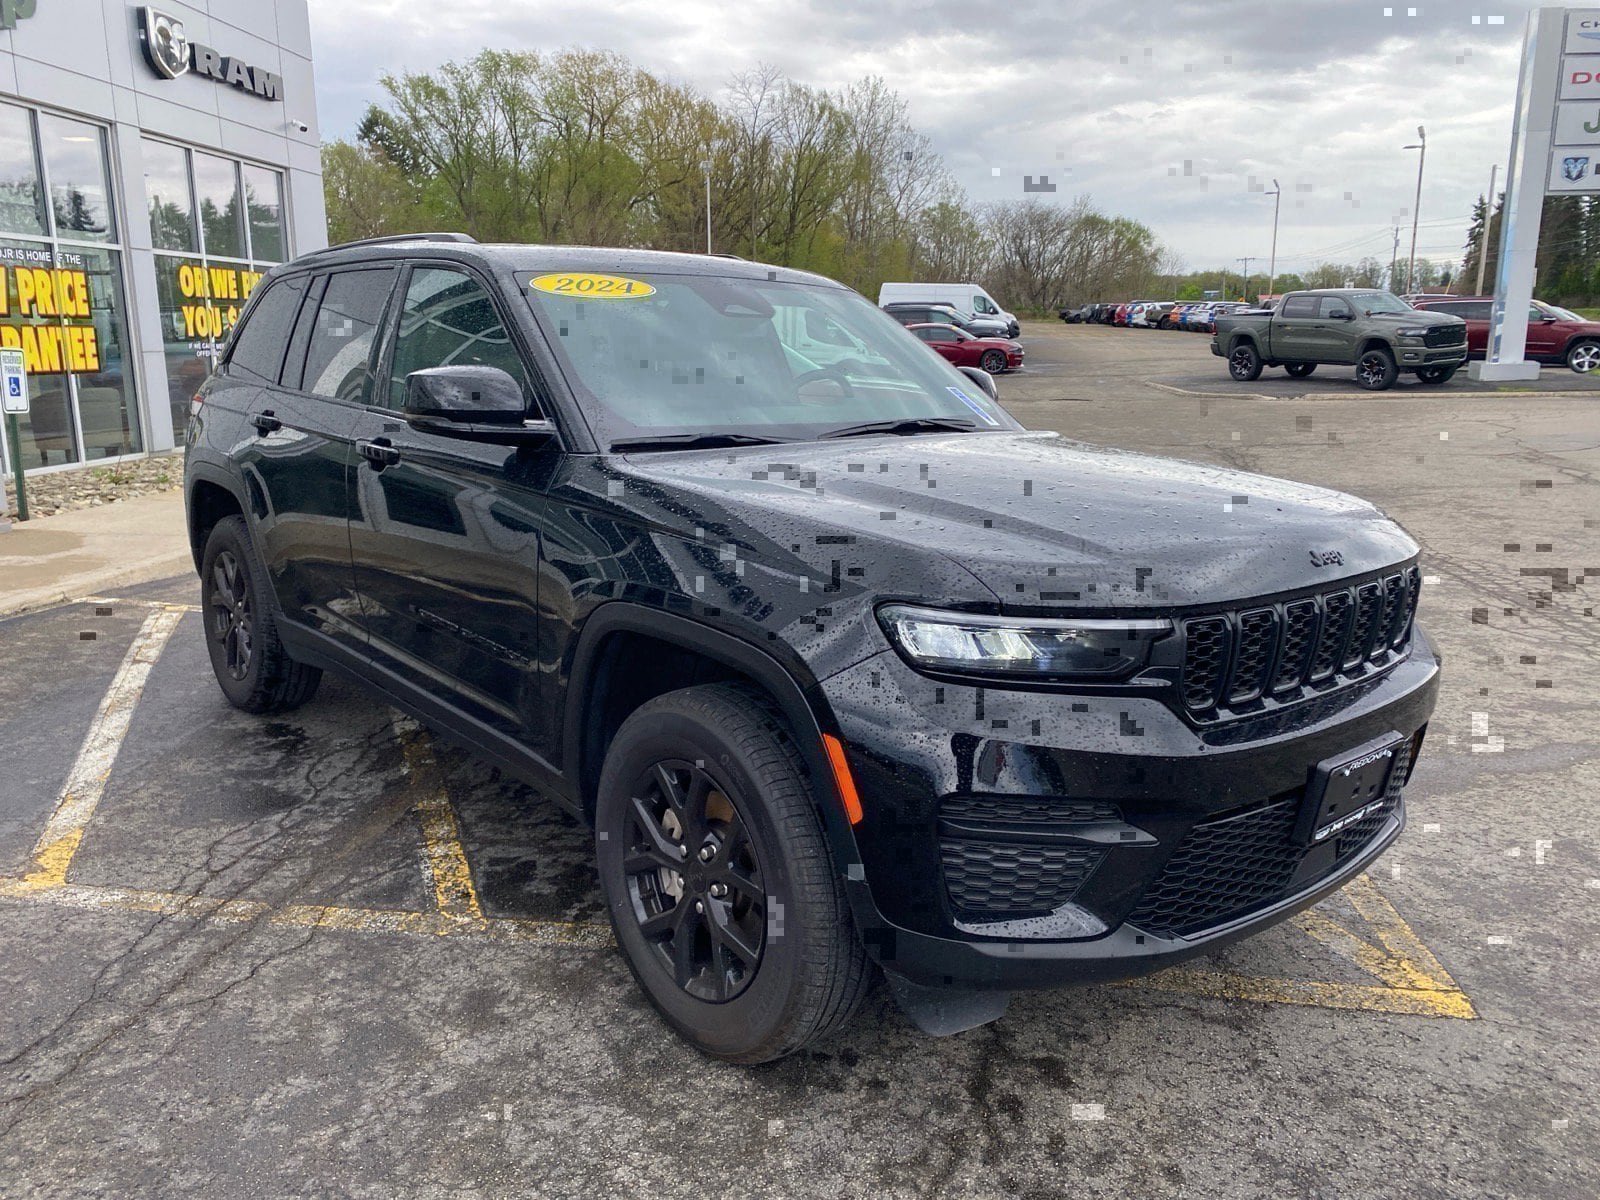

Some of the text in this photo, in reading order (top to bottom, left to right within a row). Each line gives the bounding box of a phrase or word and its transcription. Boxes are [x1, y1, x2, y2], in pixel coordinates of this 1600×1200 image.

[190, 43, 284, 101] RAM
[1571, 72, 1600, 85] D
[0, 248, 14, 259] JR
[15, 249, 24, 260] IS
[25, 250, 52, 262] HOME
[64, 253, 81, 265] THE
[14, 265, 90, 317] PRICE
[179, 265, 211, 298] OR
[209, 267, 238, 299] WE
[554, 277, 635, 294] 2024
[181, 305, 222, 338] YOU
[1309, 549, 1345, 568] Jeep
